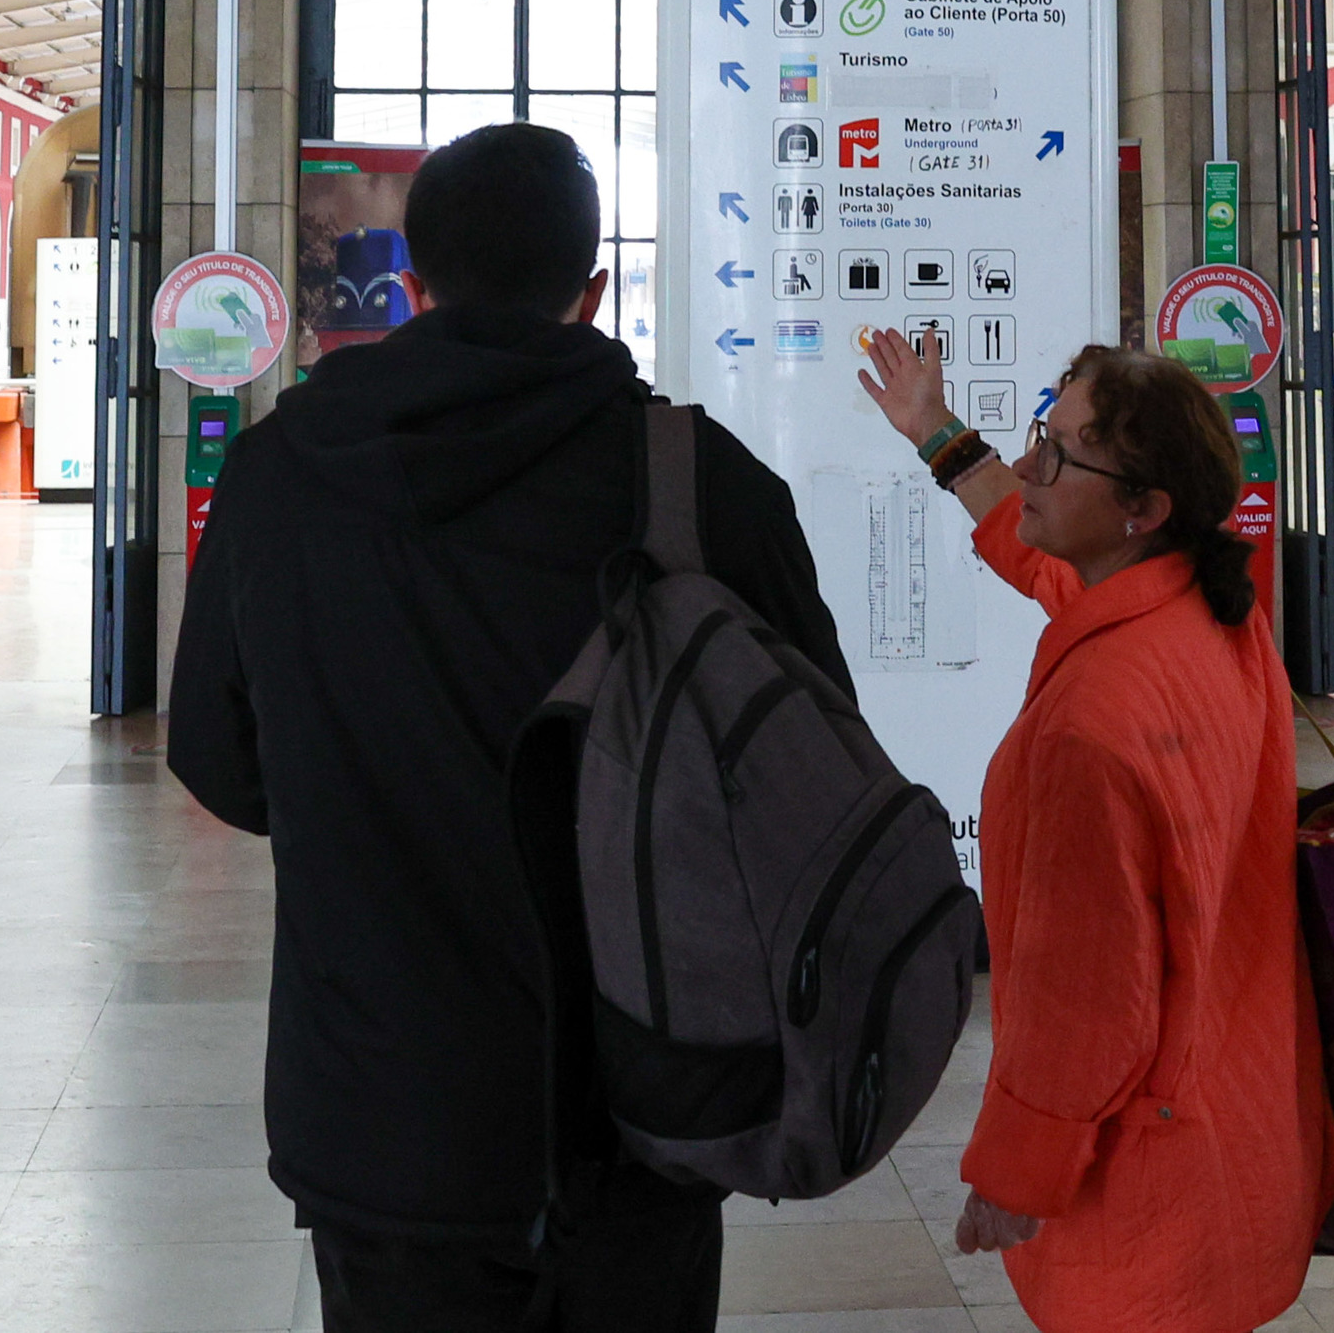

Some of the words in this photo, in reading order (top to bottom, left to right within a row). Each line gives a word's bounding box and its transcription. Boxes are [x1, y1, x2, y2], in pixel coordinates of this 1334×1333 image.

[904, 9, 924, 19] ao
[930, 5, 986, 20] Cliente
[992, 7, 1038, 24] (Porta
[1043, 9, 1065, 26] 50)
[905, 27, 934, 38] (Gate
[938, 27, 954, 38] 50)
[839, 52, 908, 67] Turismo
[905, 118, 951, 132] Metro
[842, 128, 876, 138] metro
[905, 139, 978, 150] Underground
[840, 183, 935, 200] Instalações
[941, 183, 1021, 198] Sanitarias
[839, 203, 873, 215] (Porta
[877, 203, 893, 215] 30)
[840, 218, 876, 227] Toilets
[881, 217, 910, 229] (Gate
[915, 218, 931, 229] 30)
[1226, 273, 1238, 282] DE
[1235, 512, 1272, 523] VALIDE
[1241, 524, 1267, 535] AQUI
